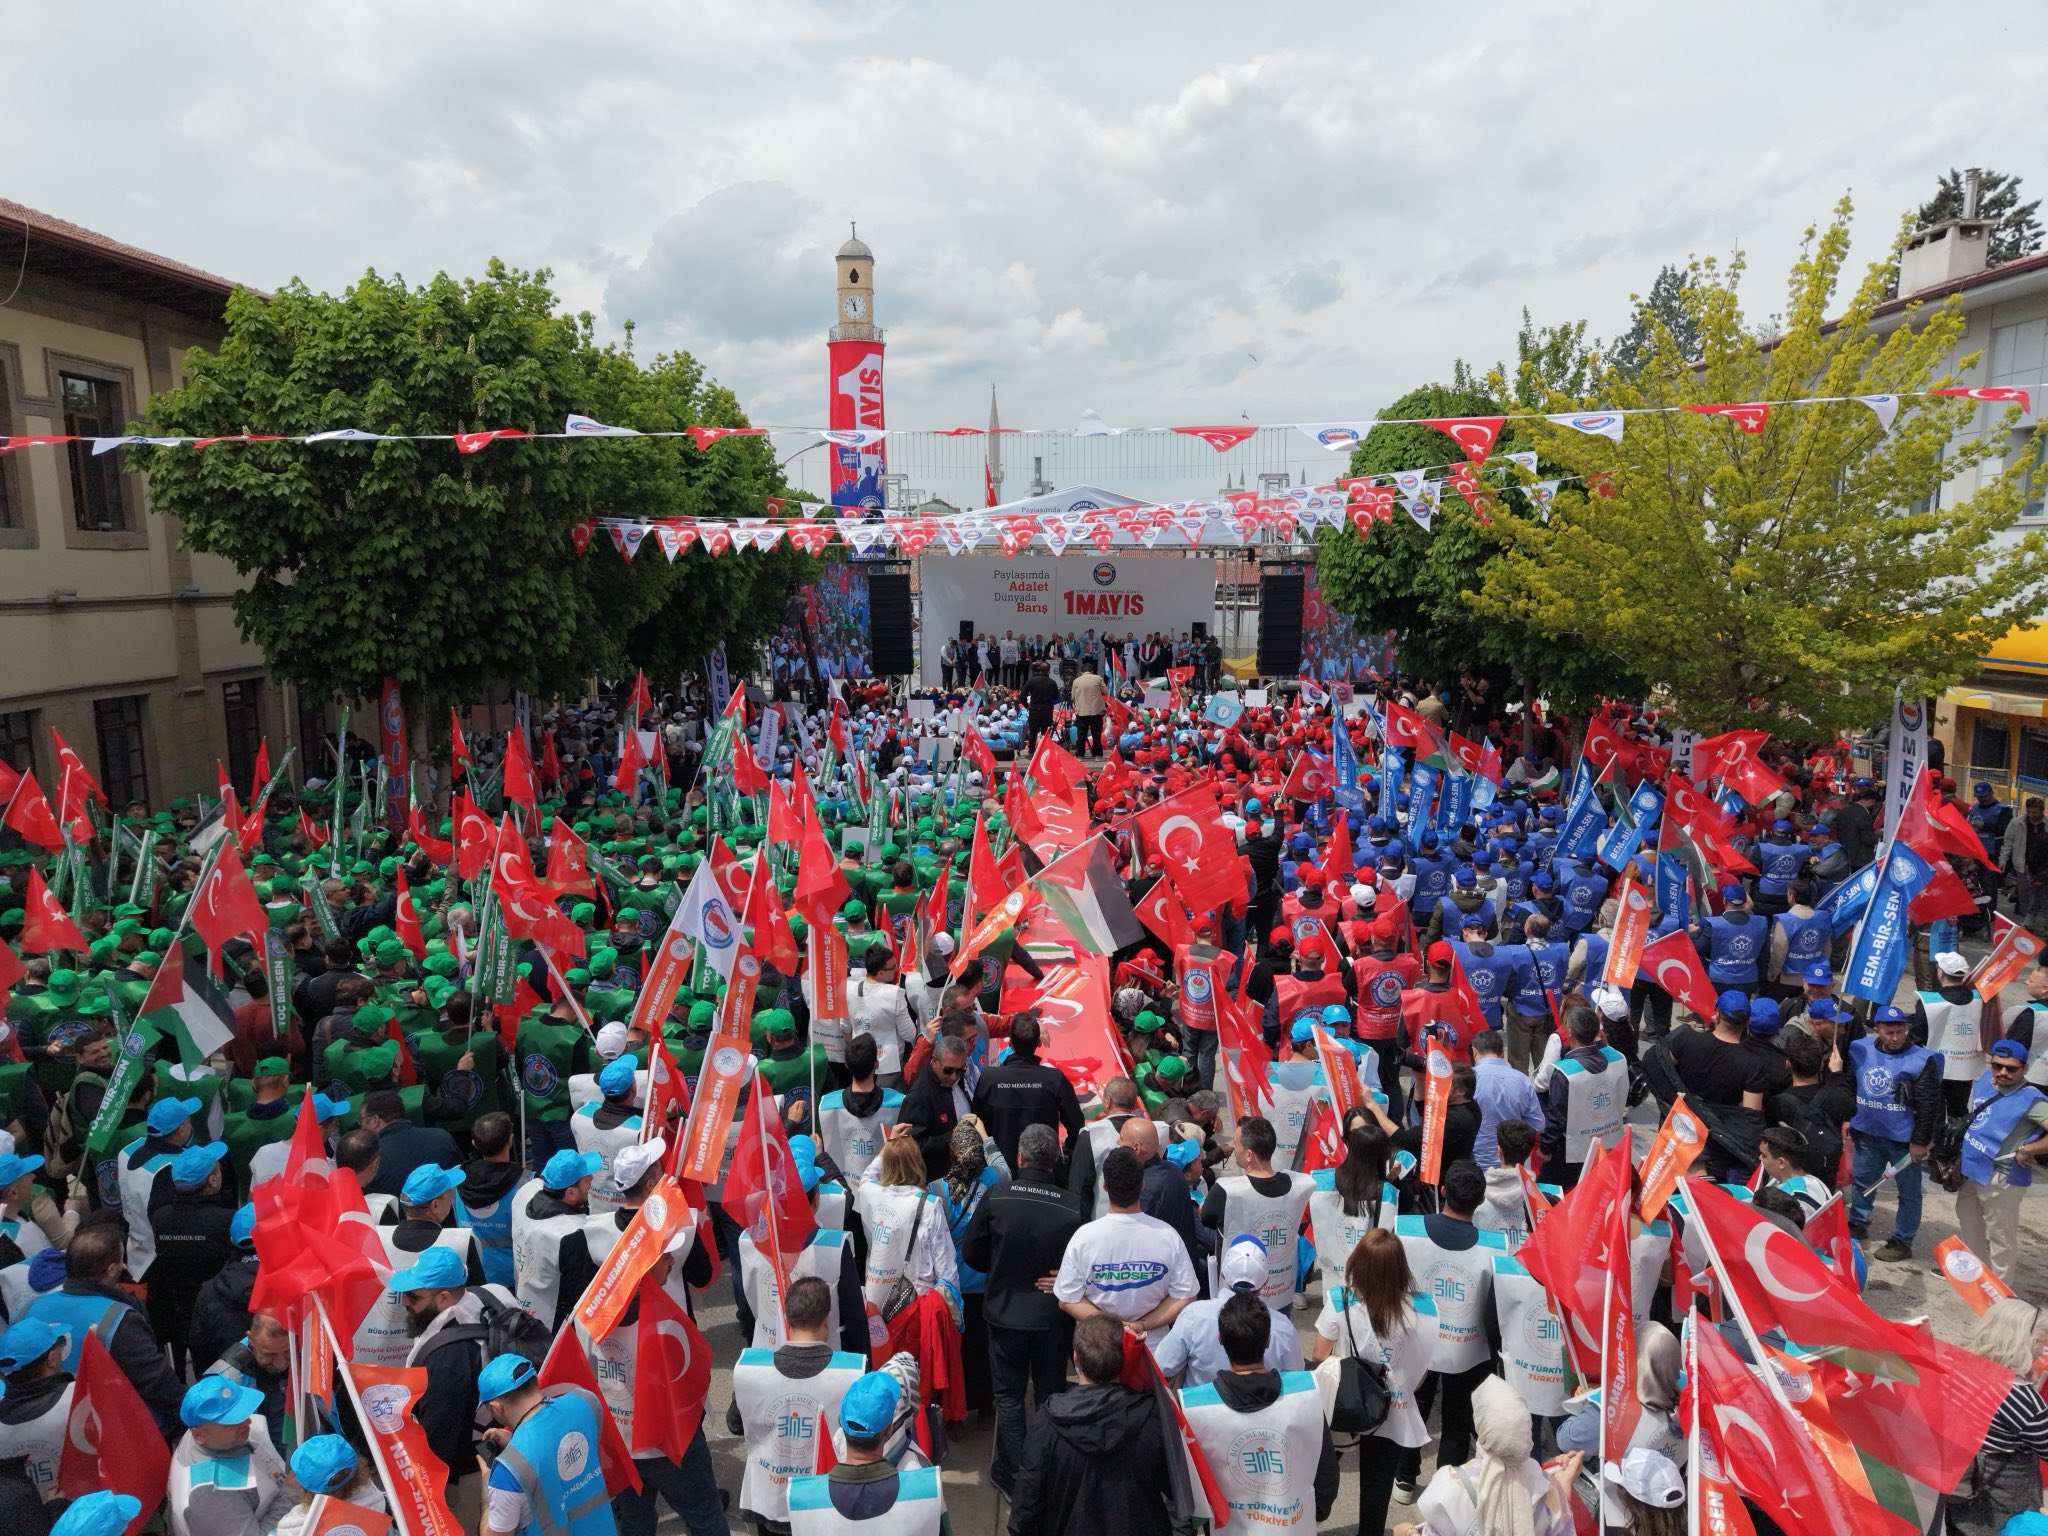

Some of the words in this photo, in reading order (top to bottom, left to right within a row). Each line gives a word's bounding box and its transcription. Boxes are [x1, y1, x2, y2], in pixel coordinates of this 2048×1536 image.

[993, 570, 1050, 581] Paylaşımda
[1009, 581, 1049, 592] Adalet
[994, 593, 1037, 603] Dünyada
[1016, 602, 1048, 614] Barış
[1860, 890, 1901, 988] BEM-BİR-SEN
[497, 935, 509, 977] BİR-SEN
[274, 960, 285, 1004] BİR-SEN
[703, 967, 711, 990] TOÇ
[495, 980, 504, 1000] TOÇ
[277, 1005, 287, 1028] TOÇ
[732, 1026, 742, 1041] RO
[100, 1058, 130, 1112] BİR-SEN
[700, 1079, 725, 1142] MEMUR-SEN
[1857, 1096, 1907, 1113] EM-BİR-SEN
[1010, 1184, 1026, 1192] BÜRO
[1027, 1187, 1061, 1199] MEMUR-SEN
[605, 1226, 647, 1288] MEMUR-SEN
[1092, 1262, 1162, 1273] CREATIVE
[1094, 1271, 1159, 1281] MINDSET
[367, 1327, 389, 1336] BÜRO
[1439, 1323, 1481, 1336] RKİYE'YİZ
[1610, 1311, 1627, 1403] MEMUR-SEN
[569, 1466, 603, 1499] MEMUR-S
[1228, 1500, 1246, 1512] BİZ
[1246, 1512, 1288, 1528] TÜRKİYE
